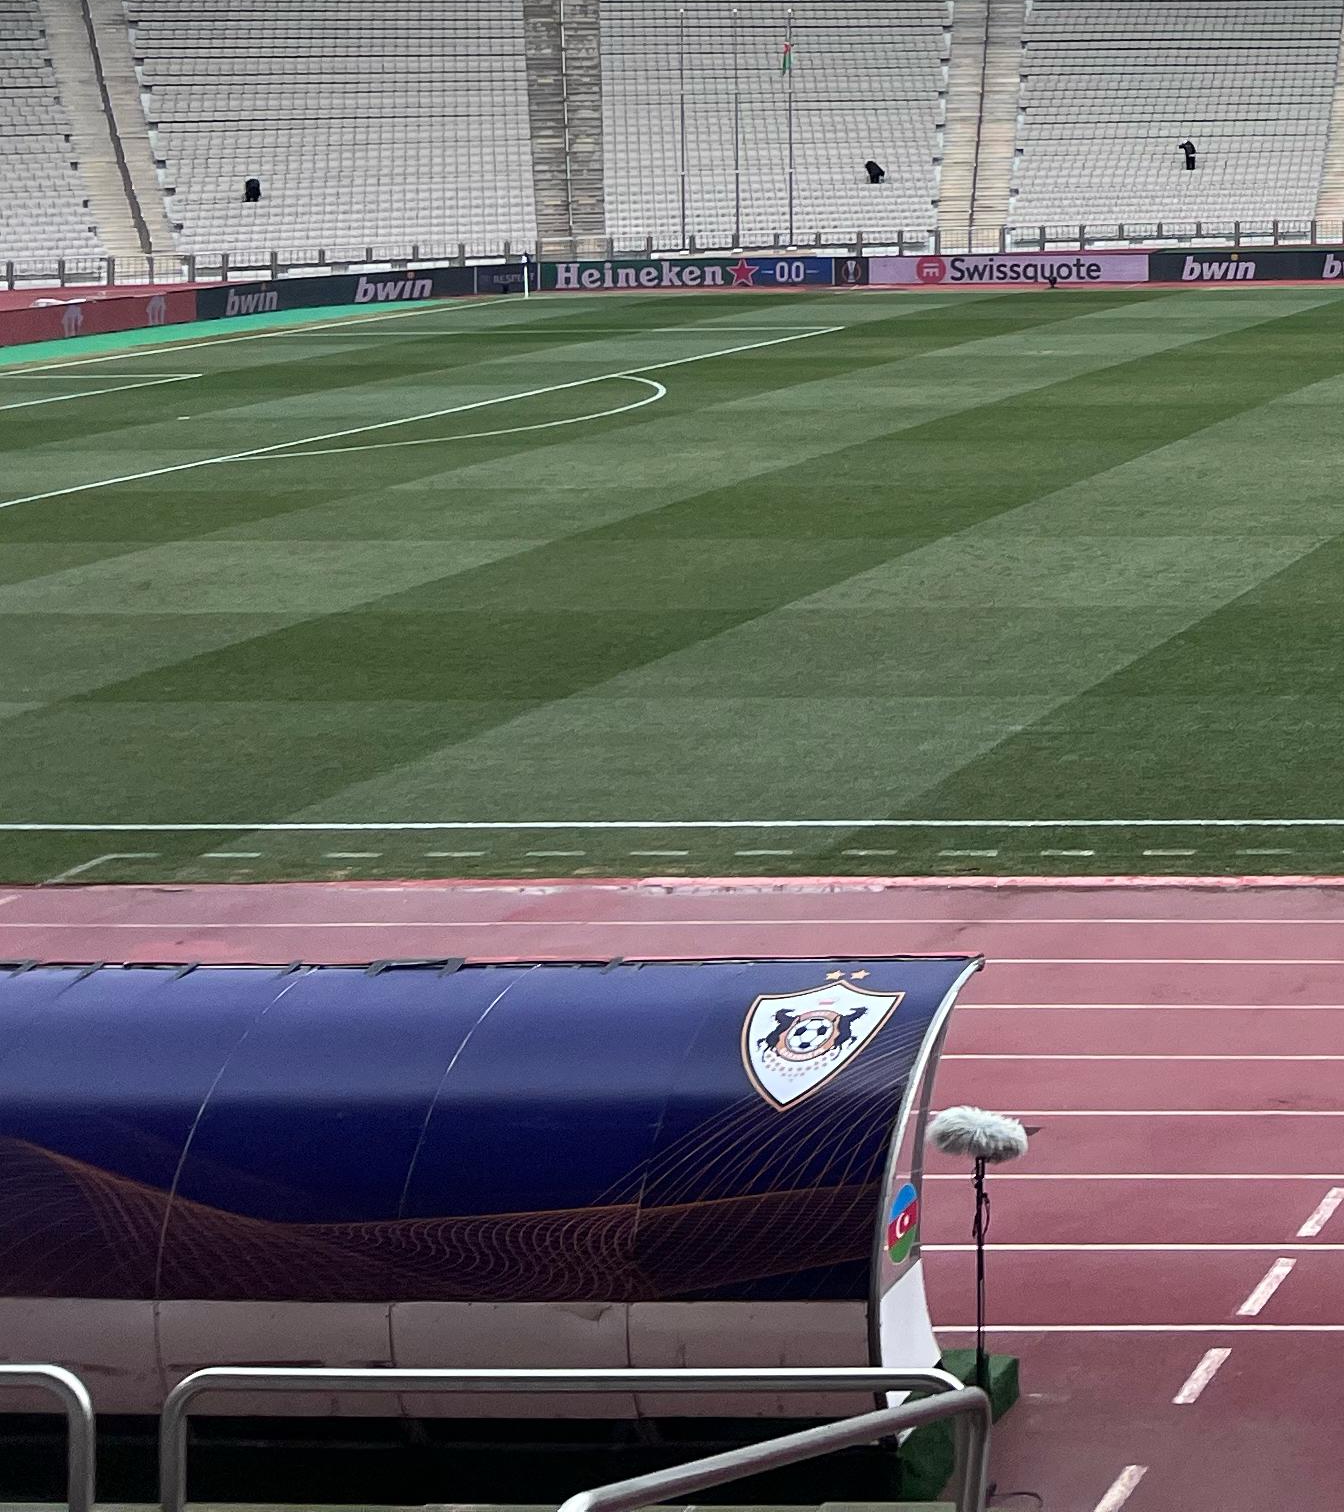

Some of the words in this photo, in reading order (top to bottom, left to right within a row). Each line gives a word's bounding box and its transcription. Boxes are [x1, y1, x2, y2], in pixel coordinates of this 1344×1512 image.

[555, 261, 725, 289] Heineken
[950, 256, 1102, 283] Swissquote
[1181, 253, 1256, 281] bwin
[225, 283, 278, 316] bwin
[354, 271, 433, 304] bwin
